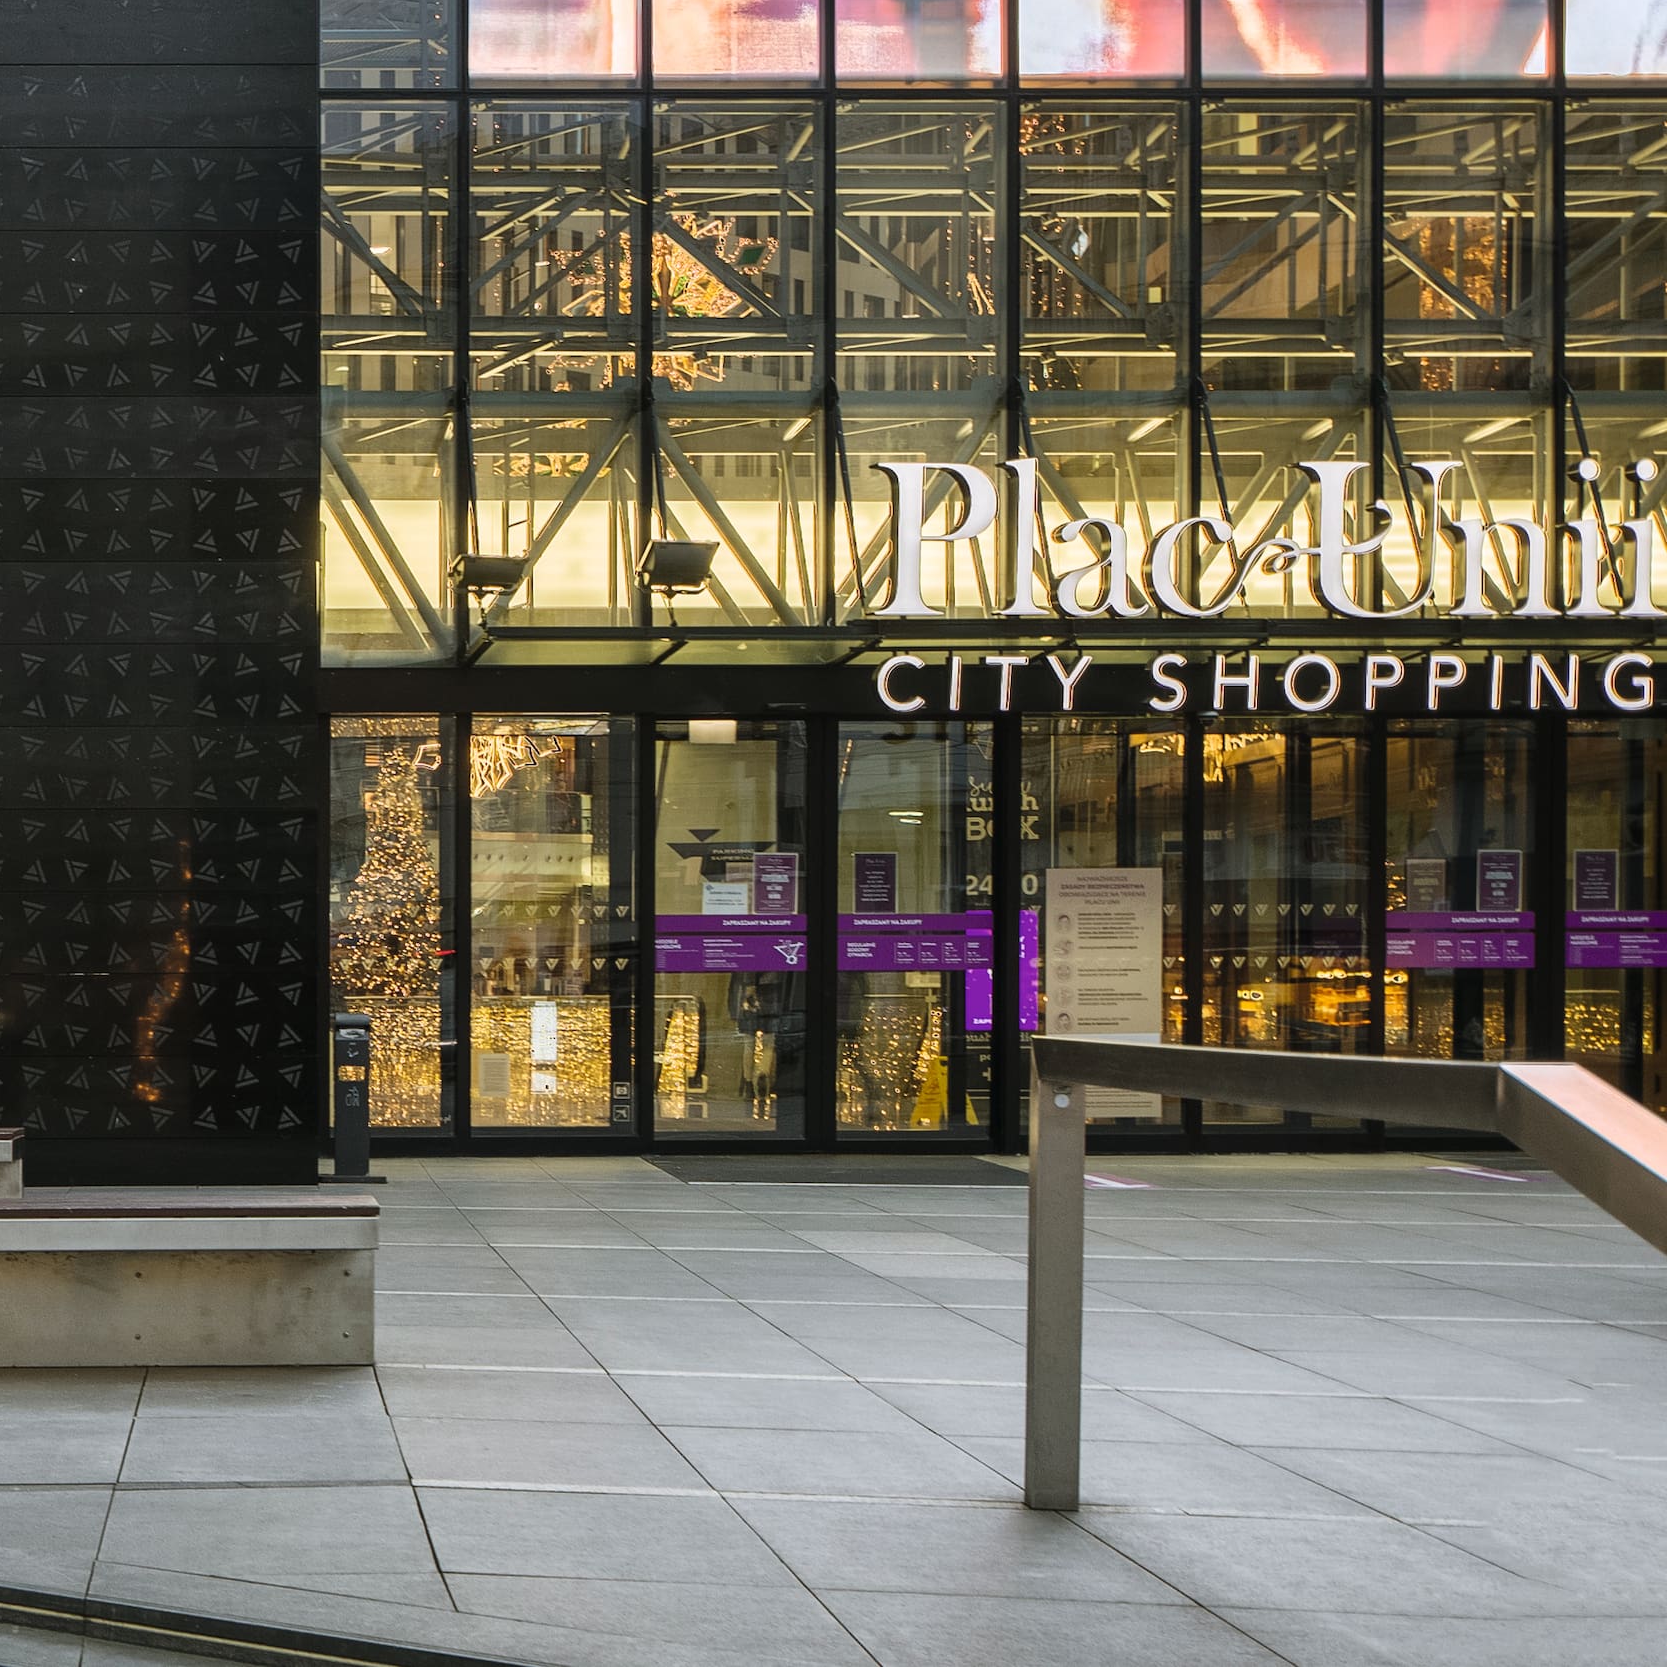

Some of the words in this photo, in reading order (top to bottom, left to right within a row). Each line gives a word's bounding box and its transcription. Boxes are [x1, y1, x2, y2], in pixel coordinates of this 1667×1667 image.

[871, 457, 1235, 617] Plac
[1284, 457, 1667, 618] Unii
[877, 654, 1092, 713] CITY
[1148, 653, 1655, 713] SHOPPING
